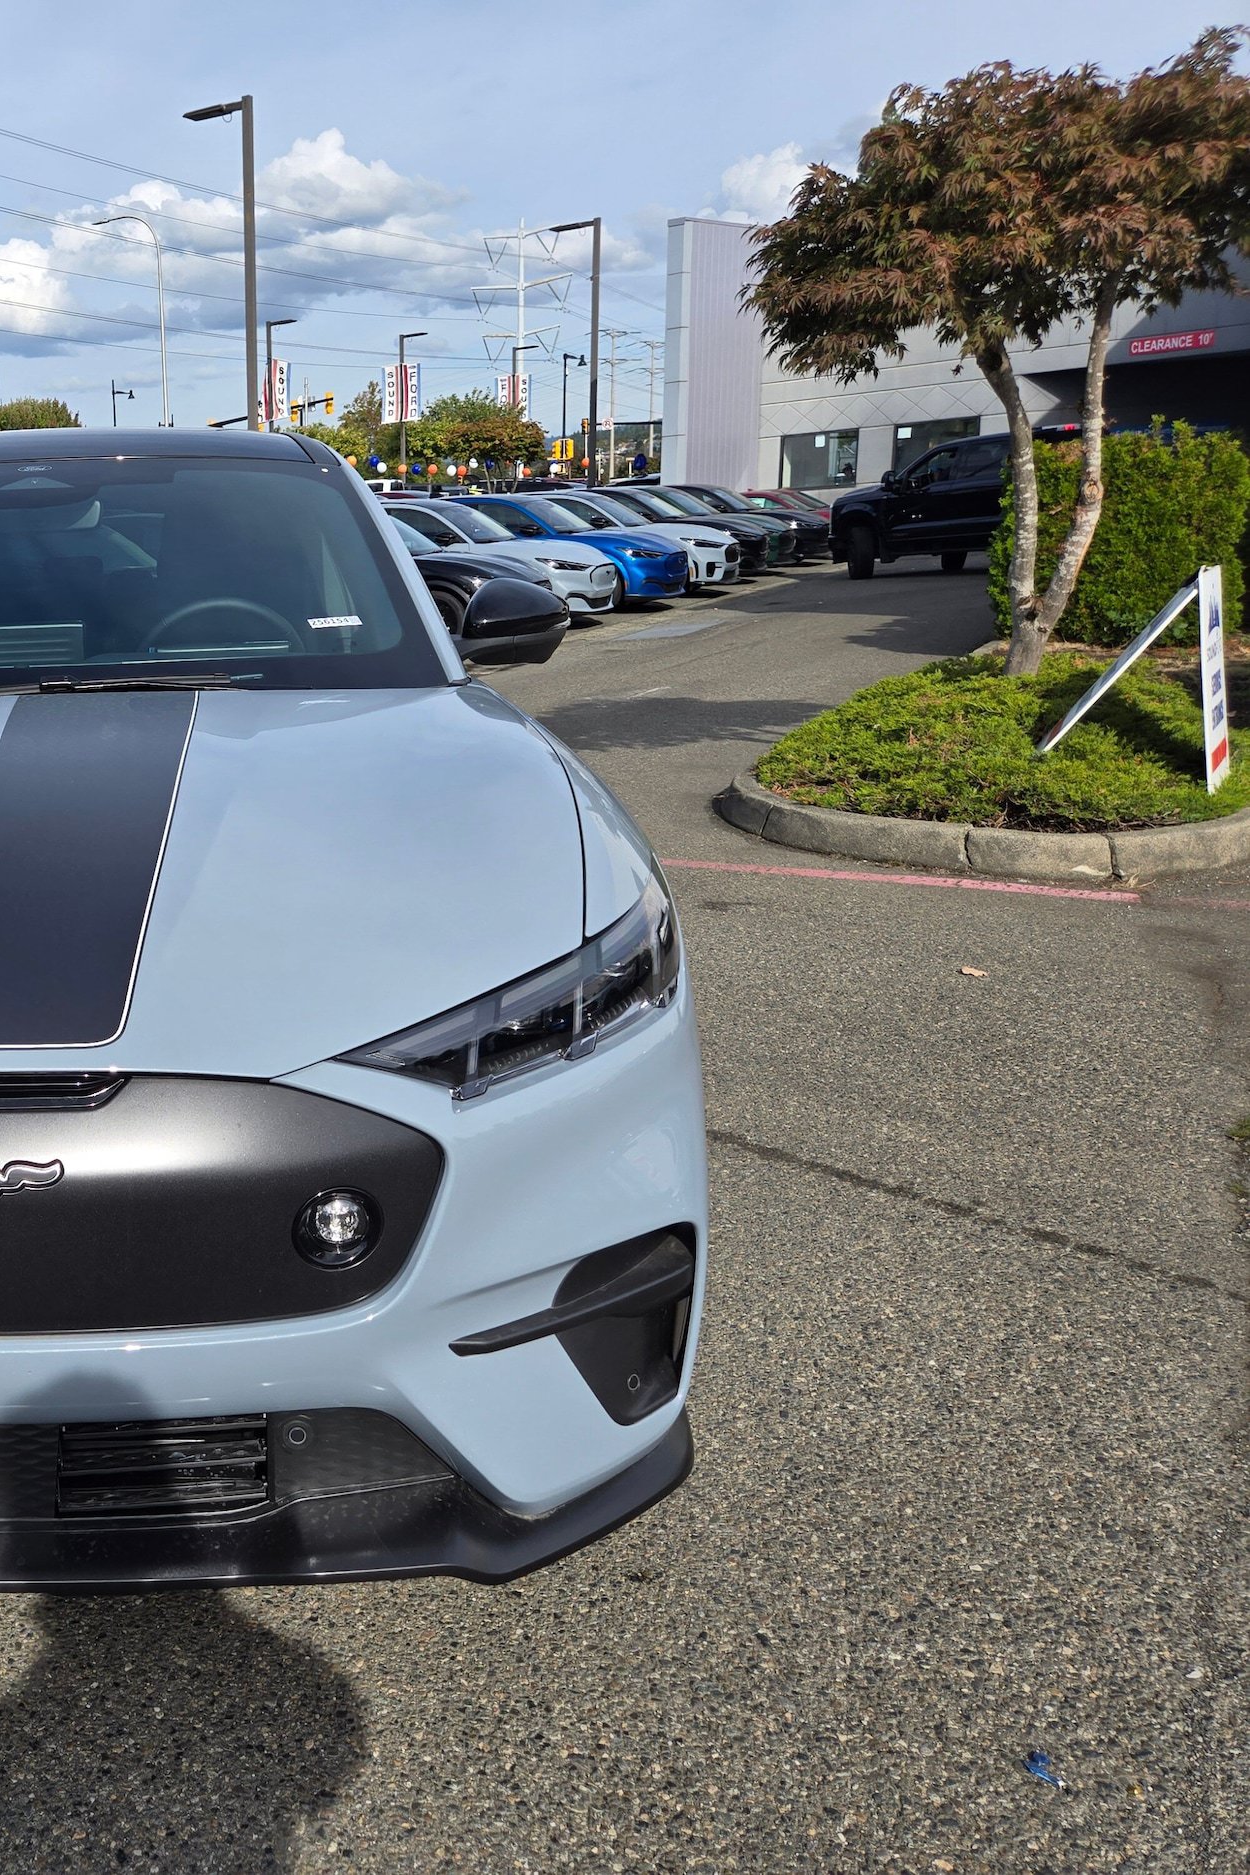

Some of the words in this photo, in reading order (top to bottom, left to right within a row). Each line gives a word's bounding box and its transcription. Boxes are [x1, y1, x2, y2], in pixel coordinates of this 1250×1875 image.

[1131, 335, 1192, 353] CLEARANCE
[387, 371, 395, 417] SOUND
[409, 371, 418, 418] FORD
